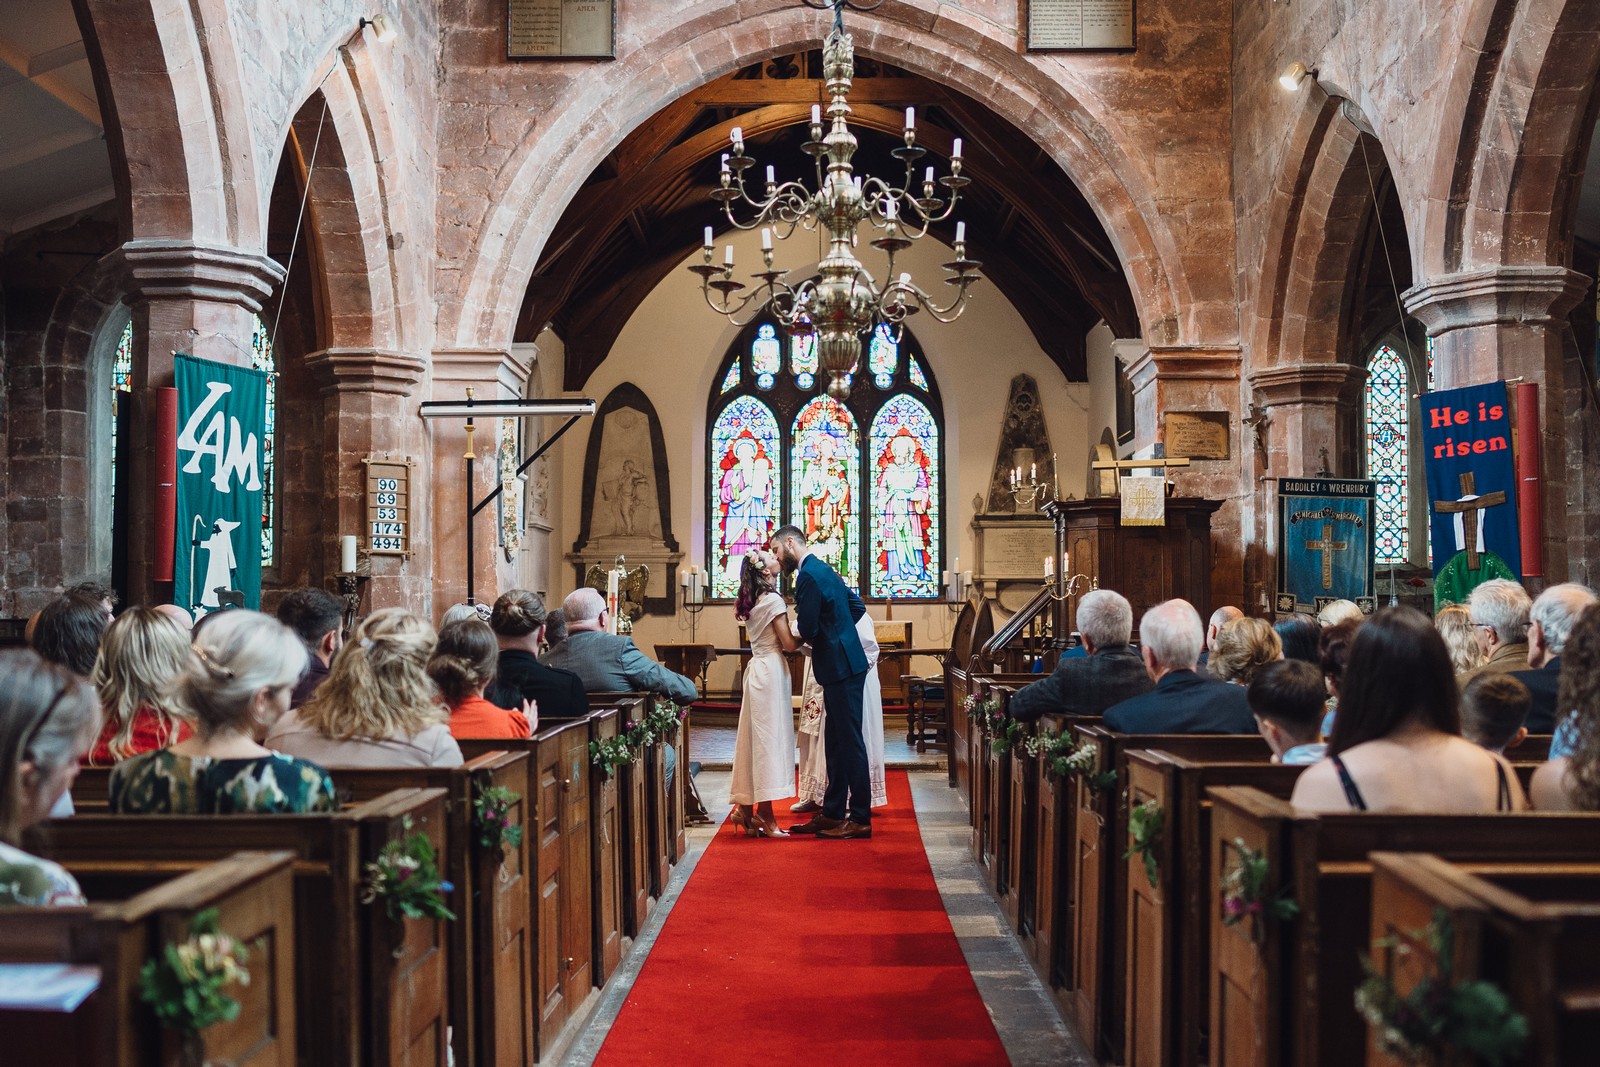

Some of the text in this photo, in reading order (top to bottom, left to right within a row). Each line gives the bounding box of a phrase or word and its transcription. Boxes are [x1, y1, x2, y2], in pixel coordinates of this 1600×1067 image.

[1429, 401, 1504, 429] He is
[1433, 435, 1508, 459] risen
[379, 479, 397, 490] 90
[1285, 481, 1321, 492] BADDILEY
[1328, 484, 1370, 494] WRENBURY
[378, 493, 396, 505] 69
[378, 508, 396, 520] 53
[374, 523, 402, 534] 174
[373, 538, 401, 549] 494
